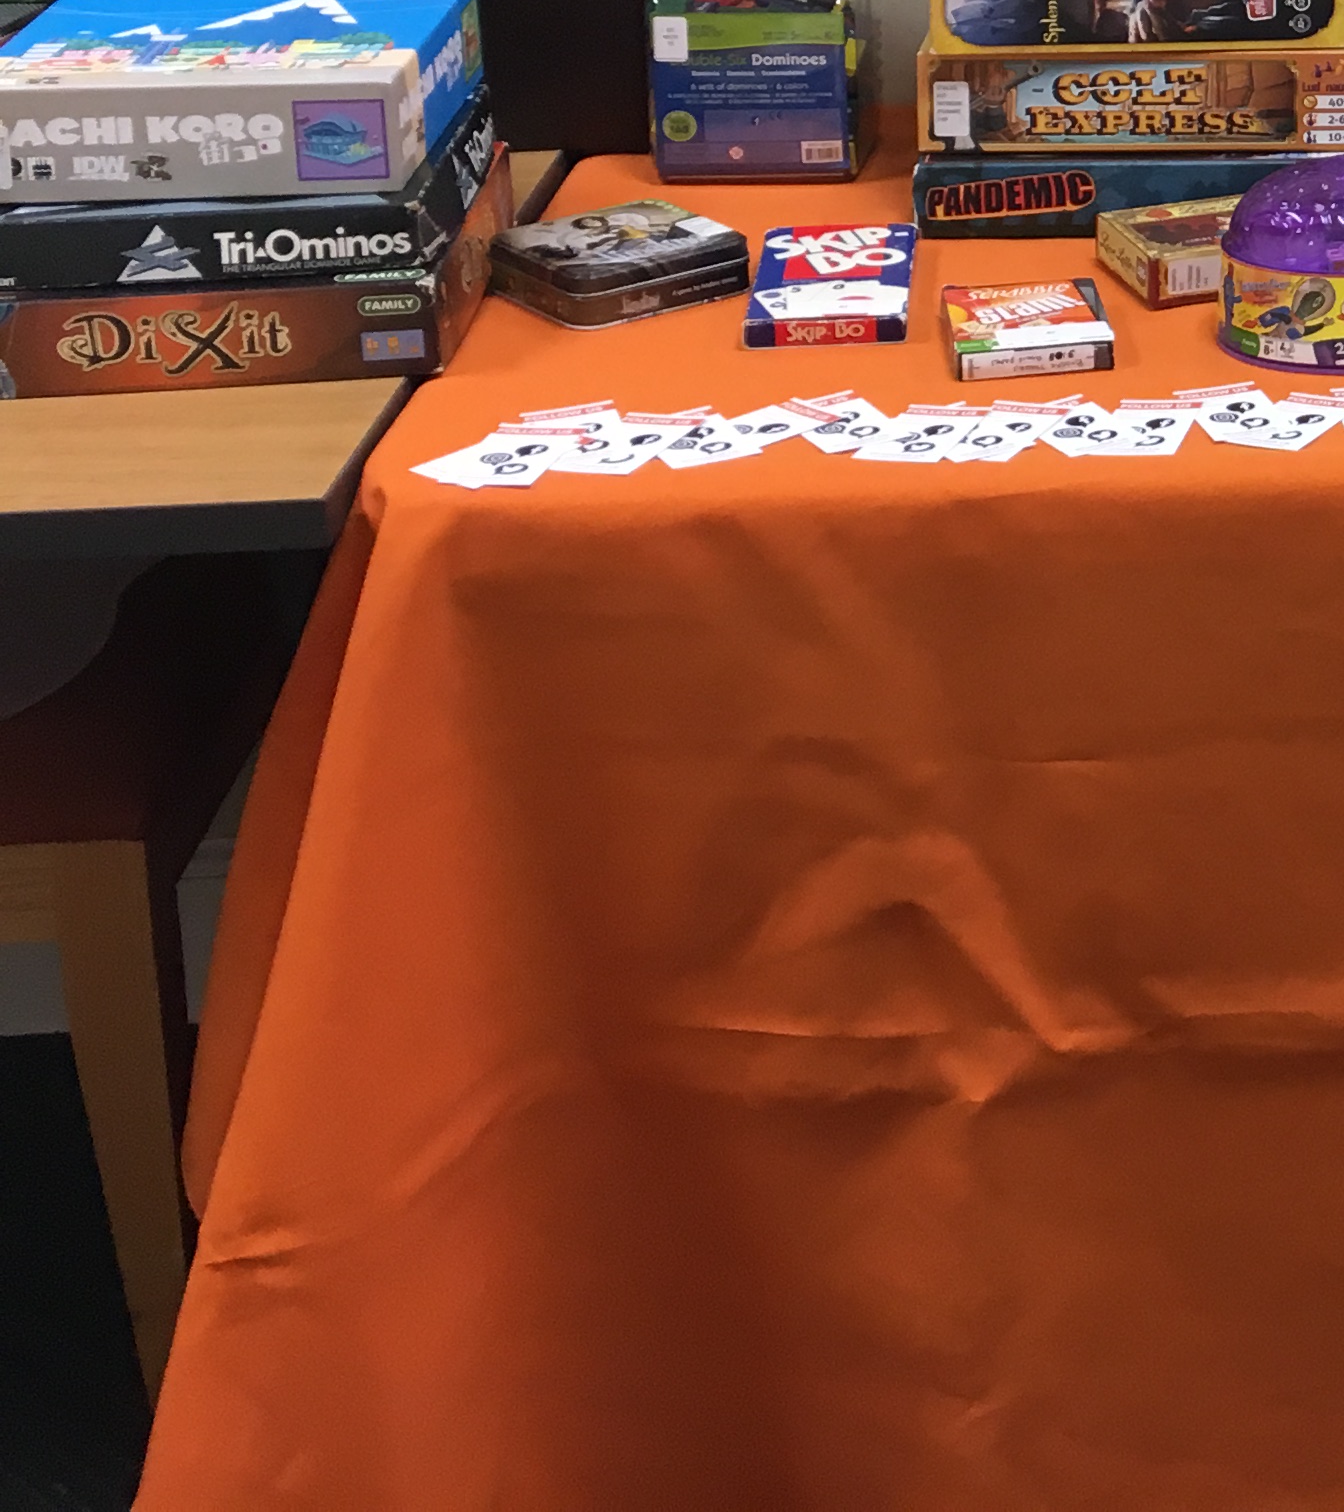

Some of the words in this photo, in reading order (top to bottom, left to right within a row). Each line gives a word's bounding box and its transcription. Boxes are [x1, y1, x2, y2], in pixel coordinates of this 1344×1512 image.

[751, 53, 828, 67] Dominoes
[1053, 68, 1209, 105] COLT
[145, 112, 285, 146] KORO
[1027, 105, 1259, 135] EXPRESS
[927, 171, 1094, 219] PANDEMIC
[363, 298, 414, 313] FAMILY
